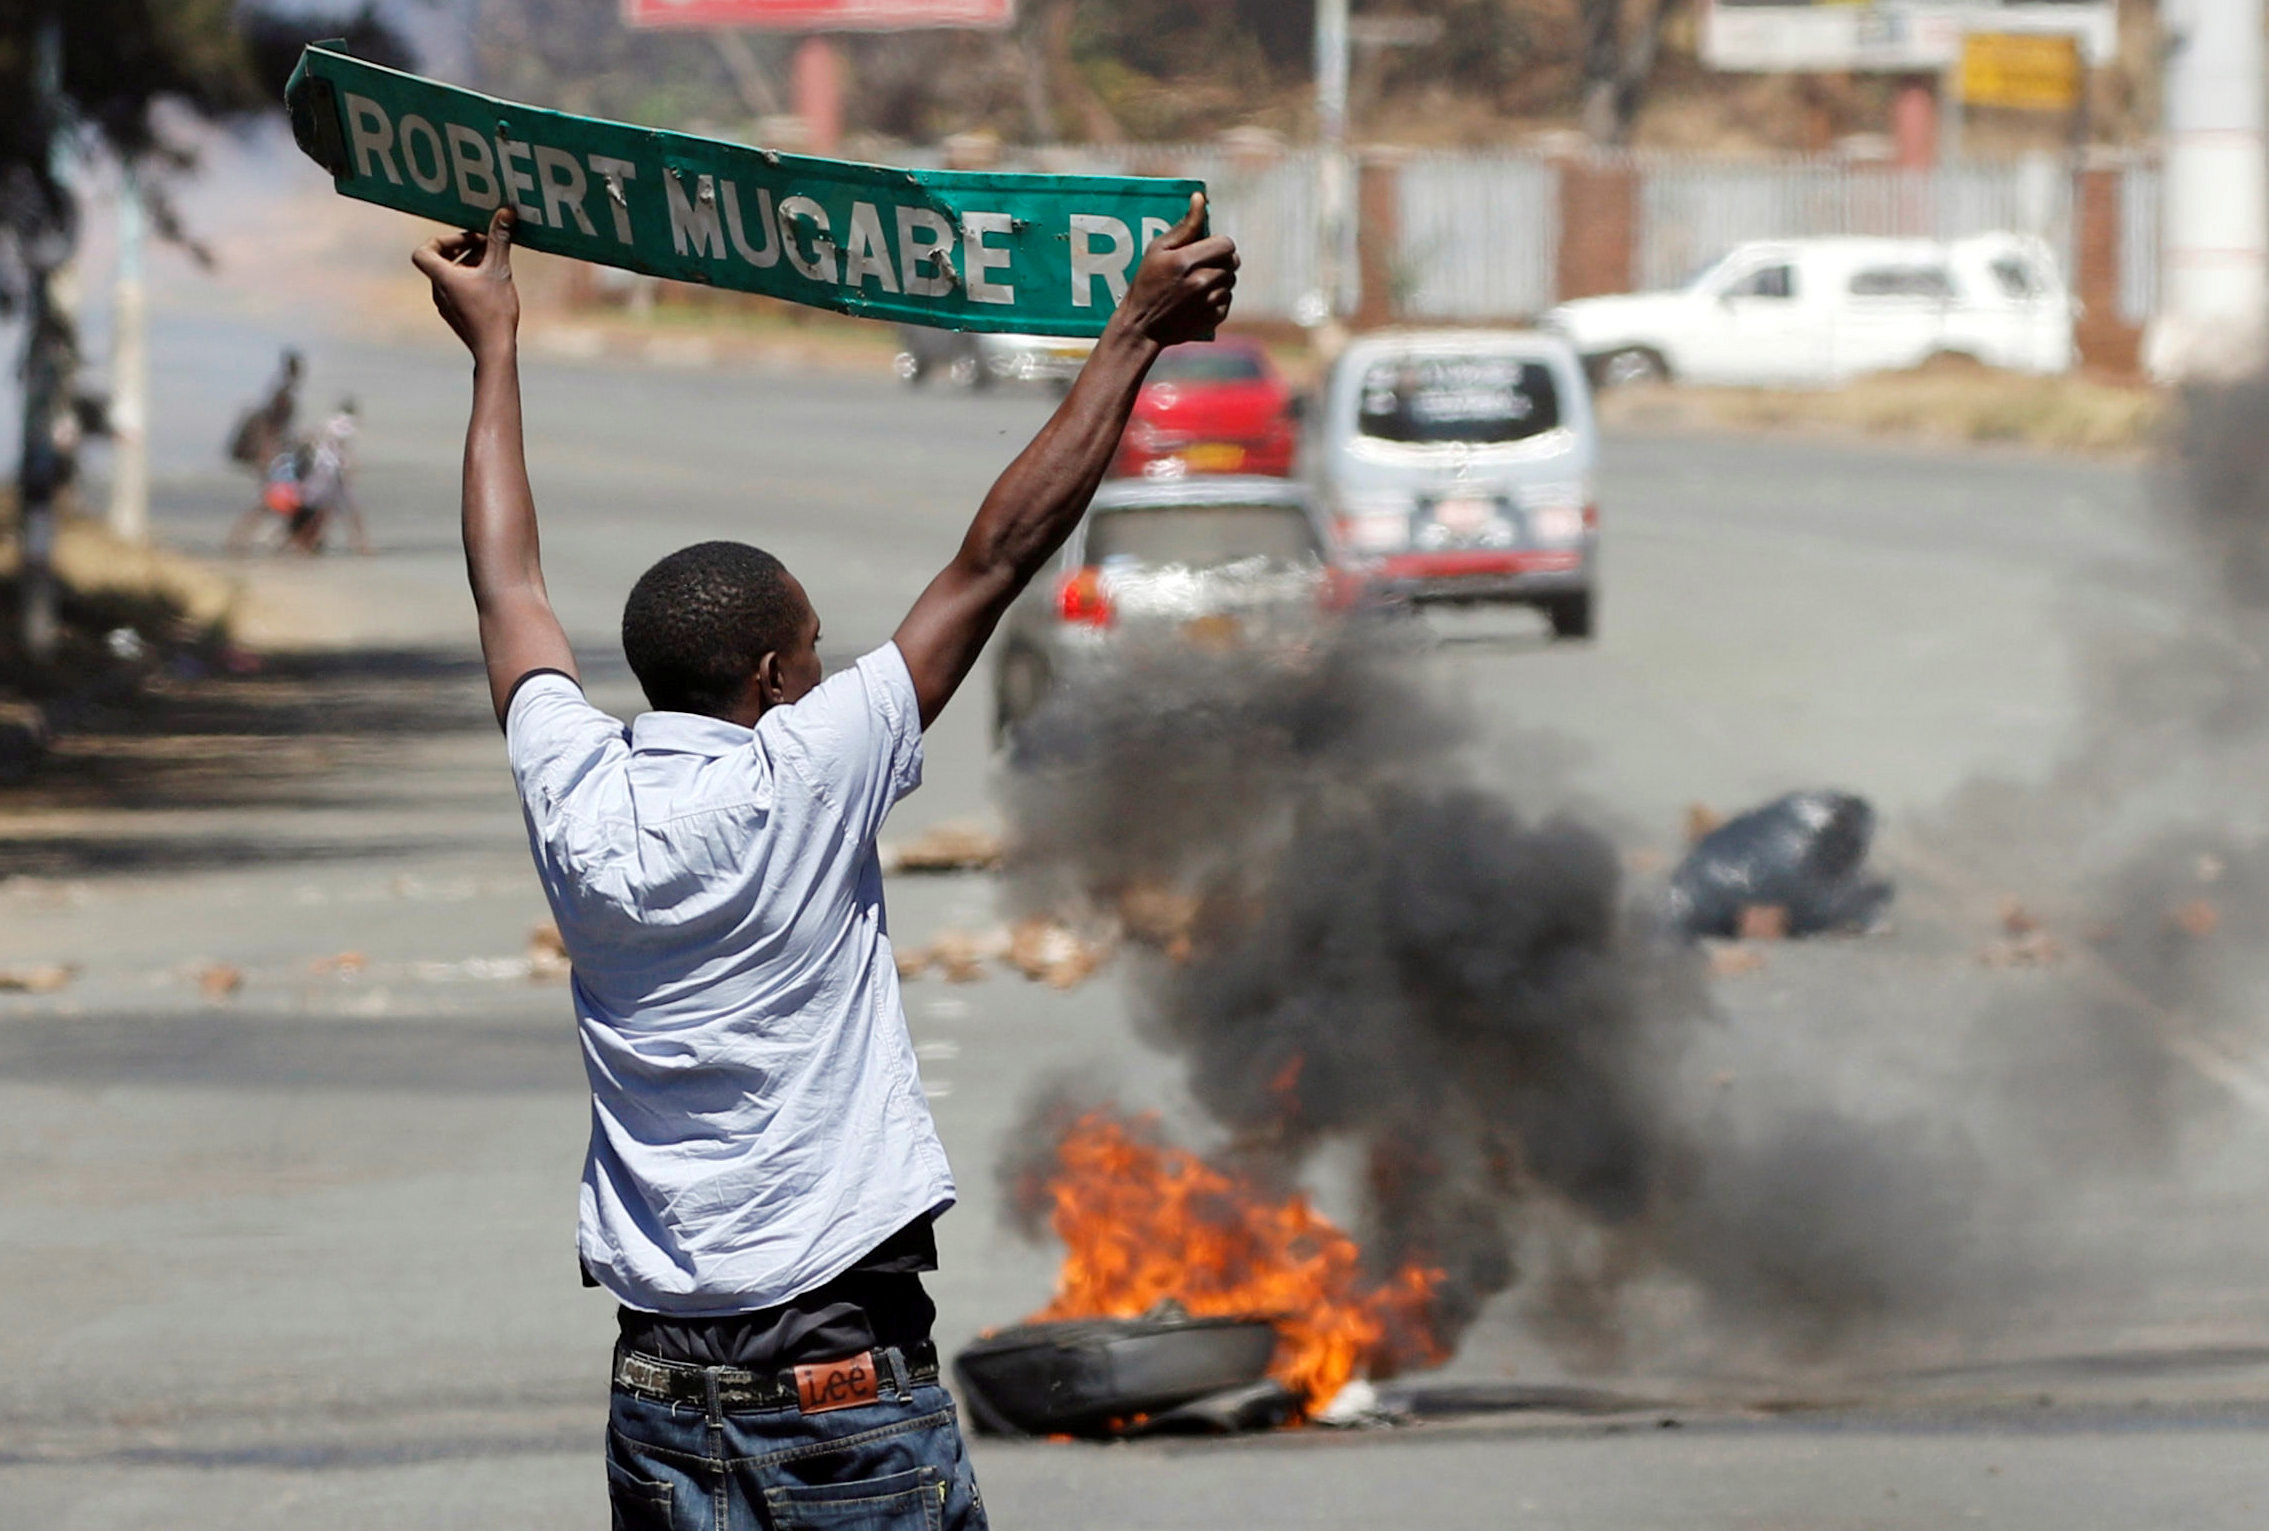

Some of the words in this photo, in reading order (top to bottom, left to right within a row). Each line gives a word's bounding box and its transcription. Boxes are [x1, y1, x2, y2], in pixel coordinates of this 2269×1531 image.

[345, 92, 637, 246] ROBERT
[664, 166, 1015, 305] MUGABE
[804, 1366, 867, 1406] Lee
